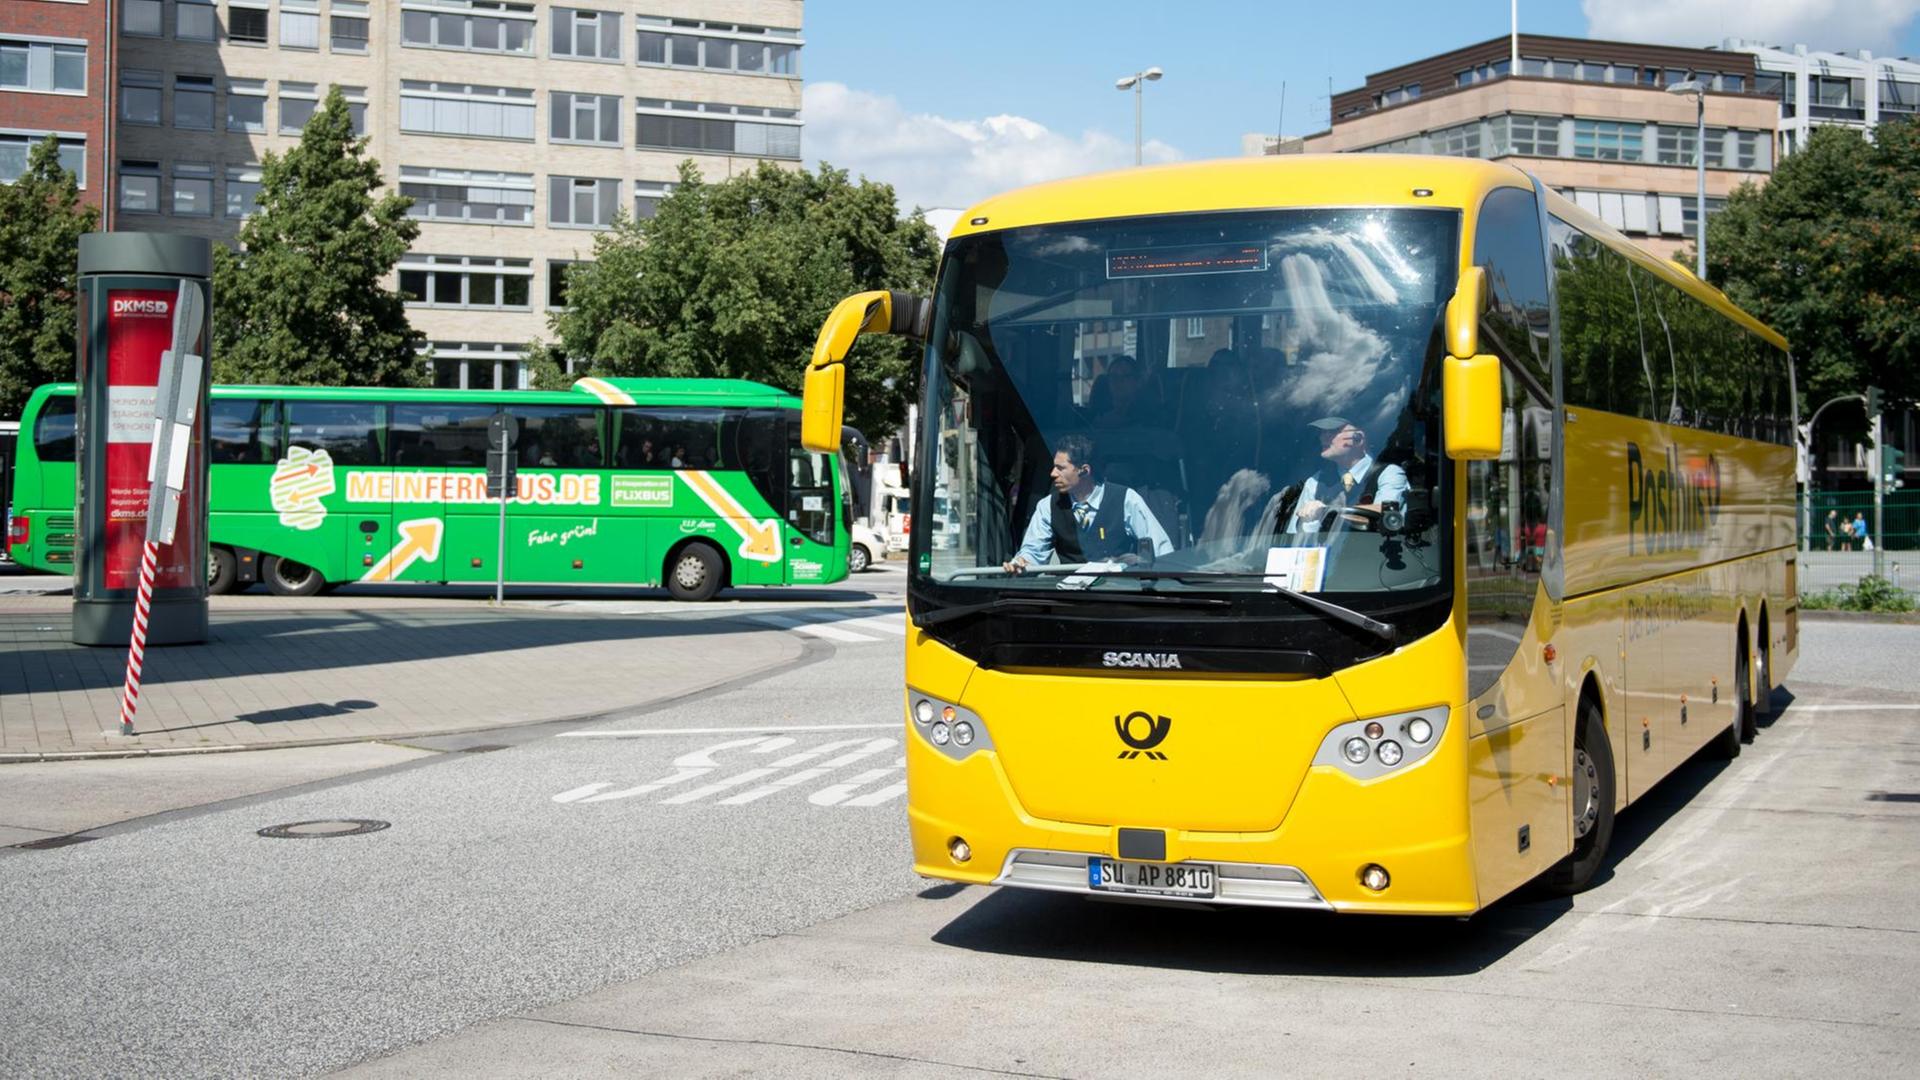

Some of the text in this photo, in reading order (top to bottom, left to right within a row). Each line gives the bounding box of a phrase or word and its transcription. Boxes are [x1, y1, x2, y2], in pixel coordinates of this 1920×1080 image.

[114, 300, 155, 313] DKMS
[528, 517, 598, 546] Fahr grün!
[1102, 651, 1182, 670] SCANIA
[1102, 863, 1123, 884] SU
[1138, 865, 1160, 886] AP
[1165, 867, 1209, 890] 8810
